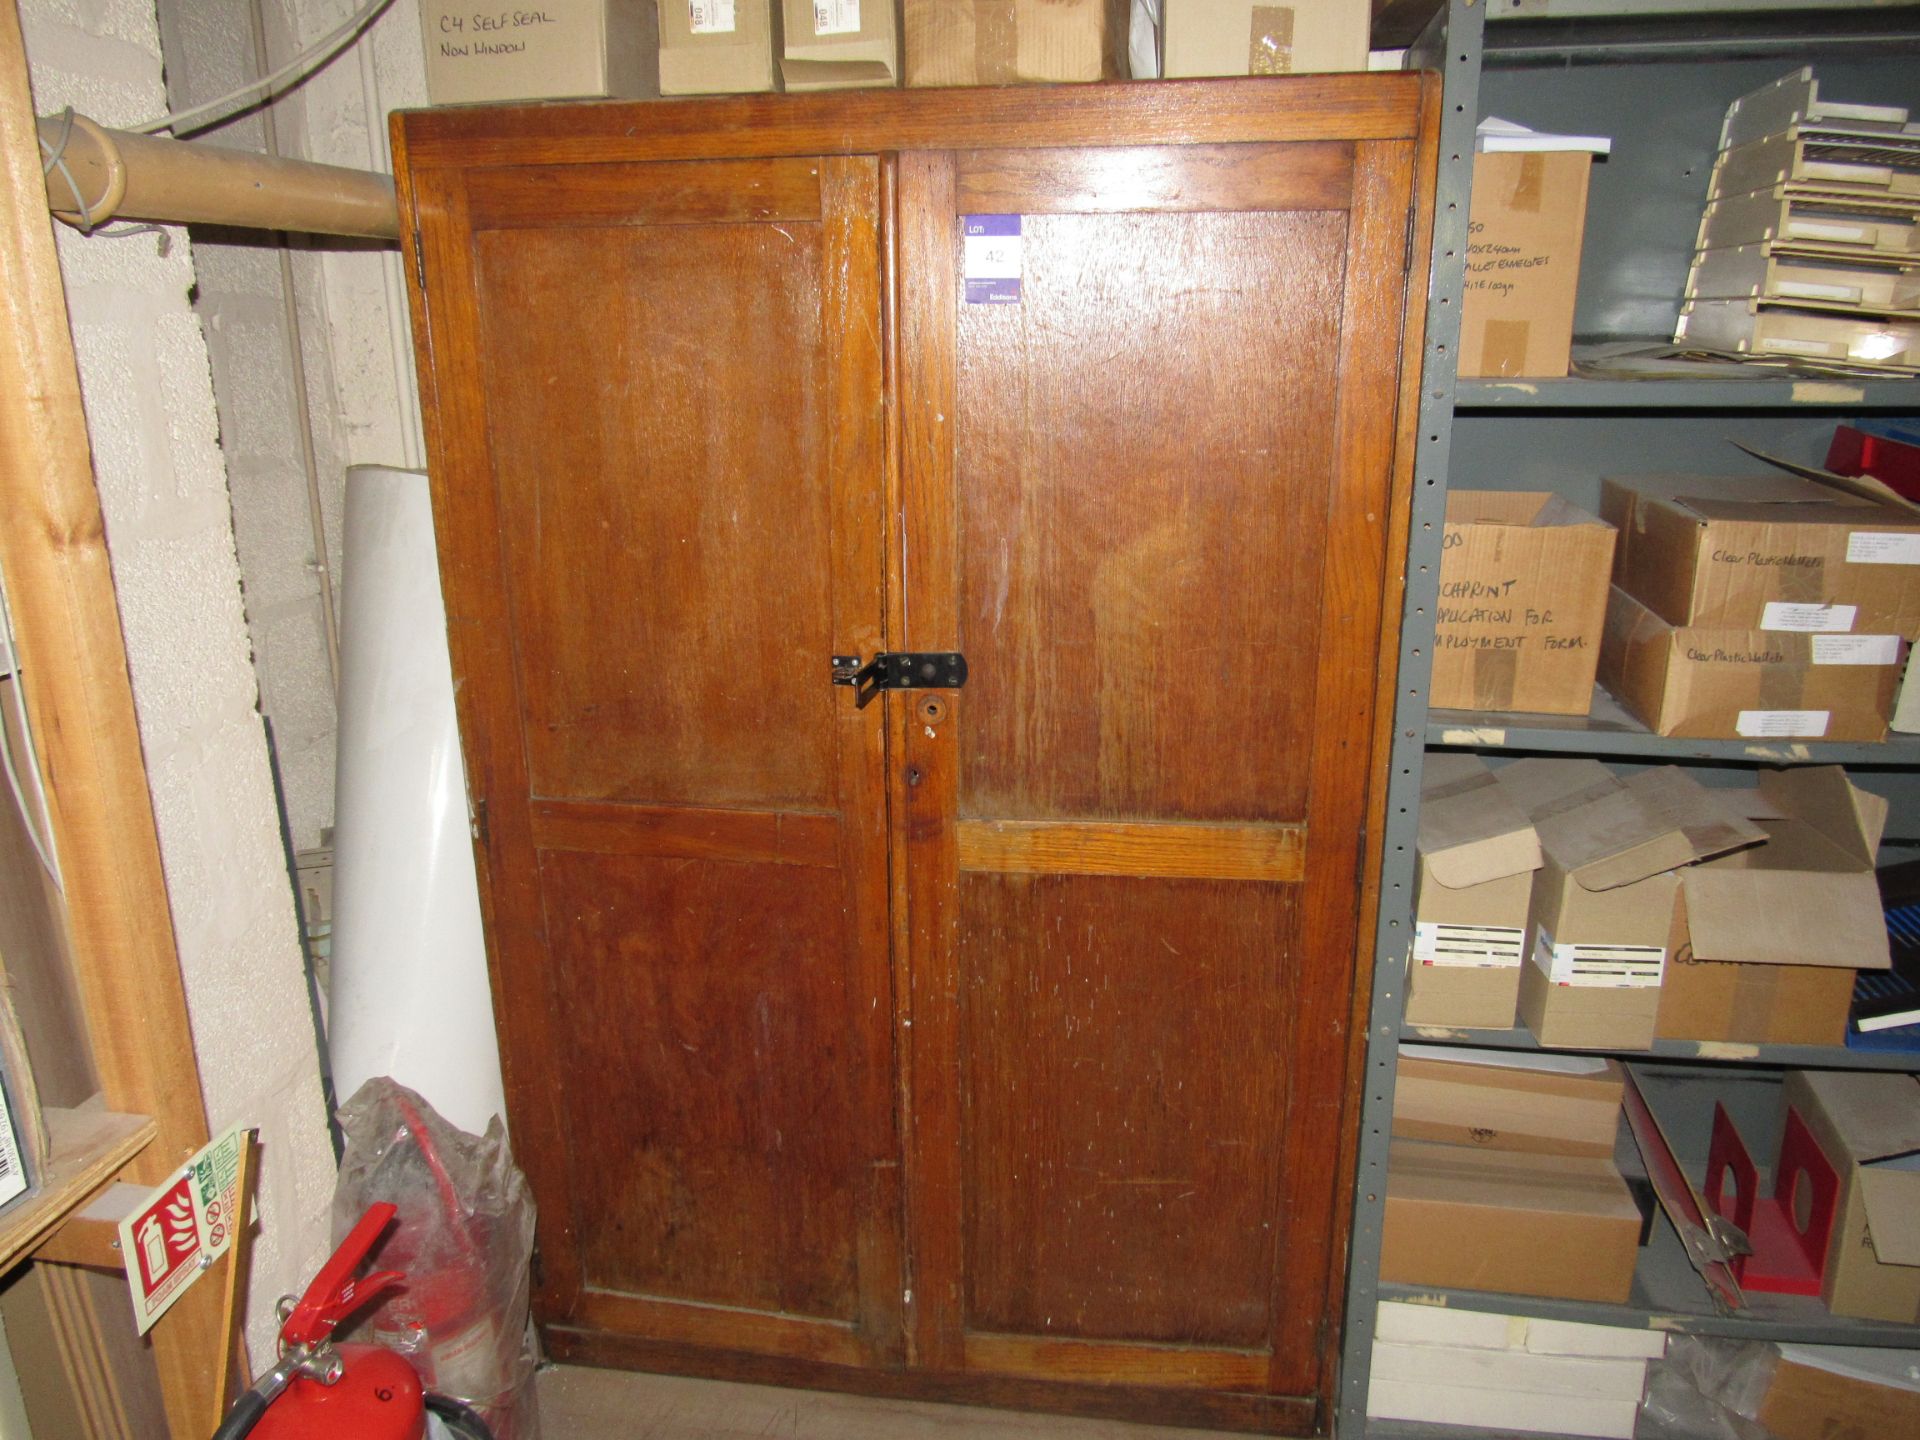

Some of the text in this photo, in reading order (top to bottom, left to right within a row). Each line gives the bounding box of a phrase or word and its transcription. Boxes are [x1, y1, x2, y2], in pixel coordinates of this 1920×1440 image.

[440, 10, 557, 33] C4 SELF SEAL
[474, 40, 526, 56] WINDOW
[1711, 550, 1744, 564] Clear
[1747, 551, 1781, 567] Plastic
[1686, 647, 1784, 664] Clear Plastic Wallets
